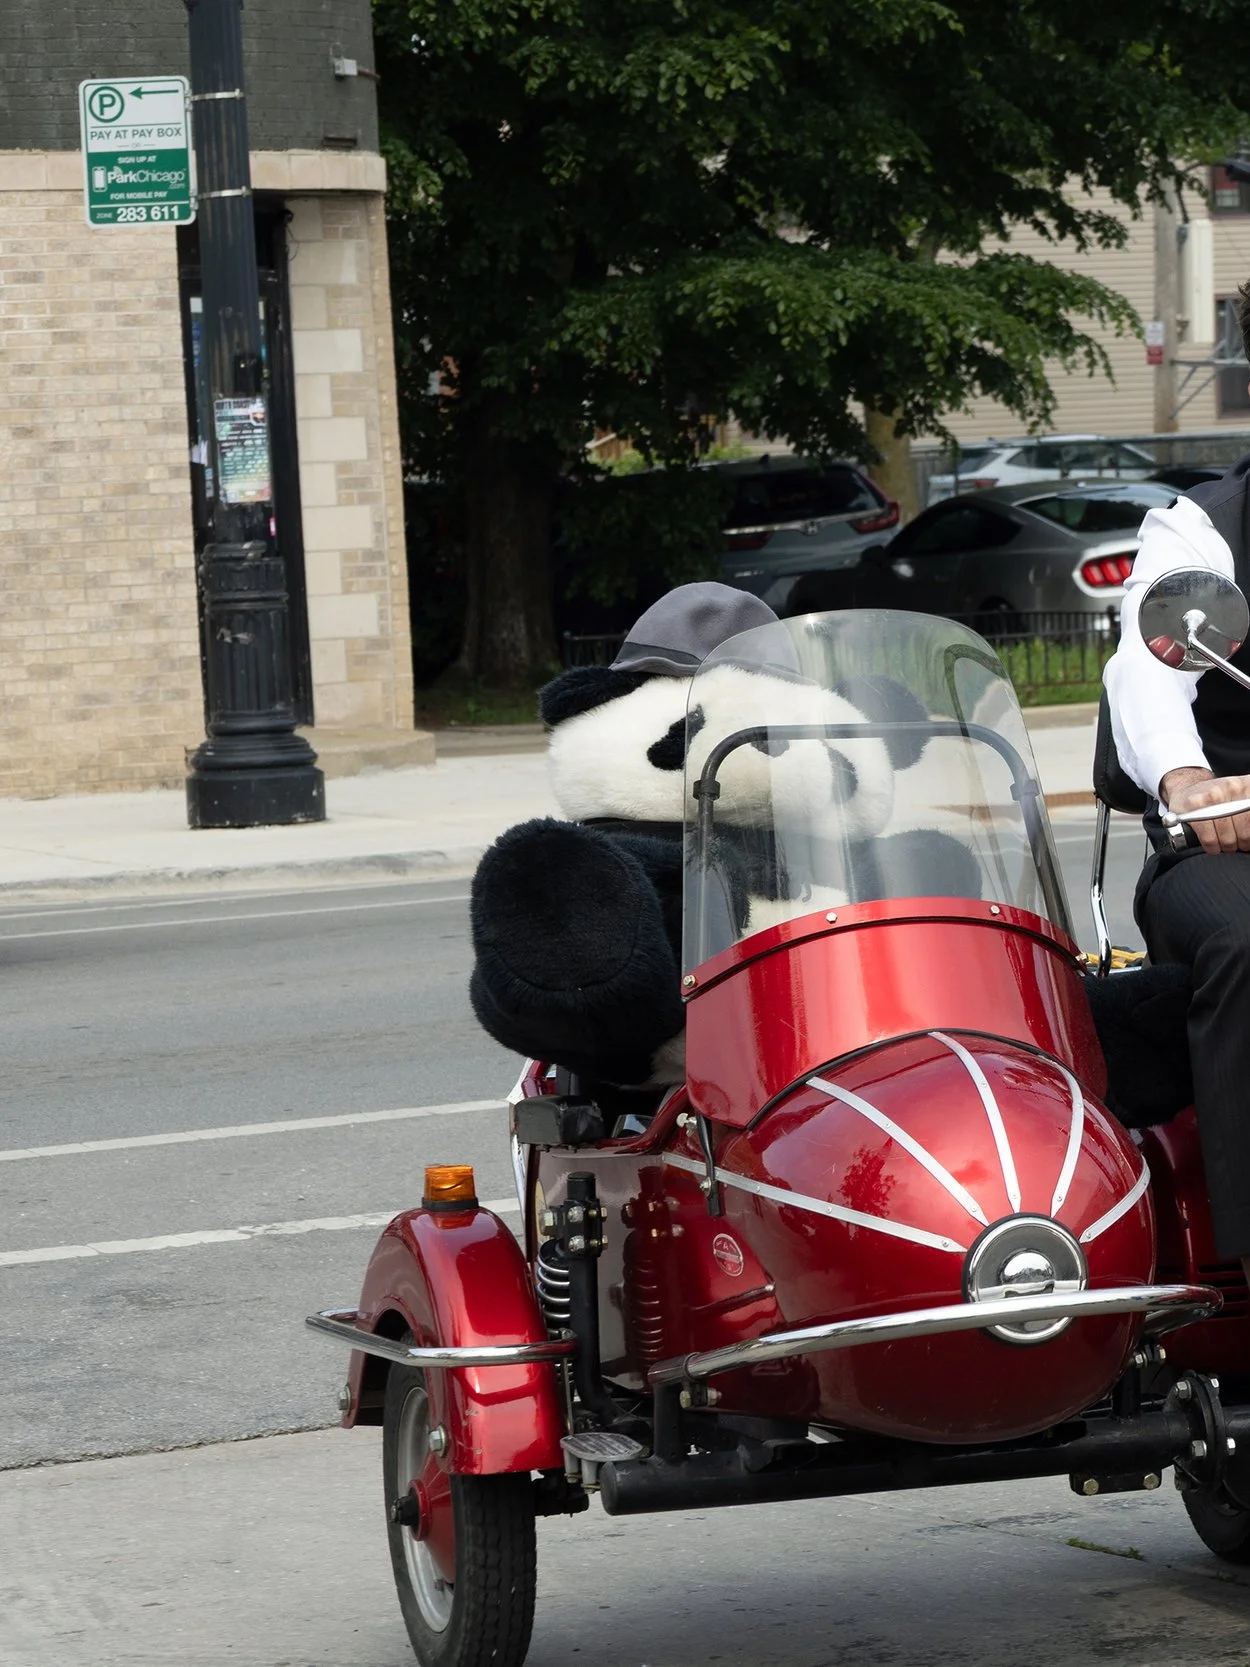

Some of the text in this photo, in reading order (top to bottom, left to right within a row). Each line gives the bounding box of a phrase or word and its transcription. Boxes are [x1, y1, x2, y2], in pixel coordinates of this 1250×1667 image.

[98, 94, 116, 115] P
[90, 127, 182, 140] PAY AT PAY BOX
[107, 169, 185, 184] ParkChicago
[110, 190, 168, 200] FOR MOBILE PAY
[117, 206, 147, 222] 283
[151, 204, 179, 220] 611
